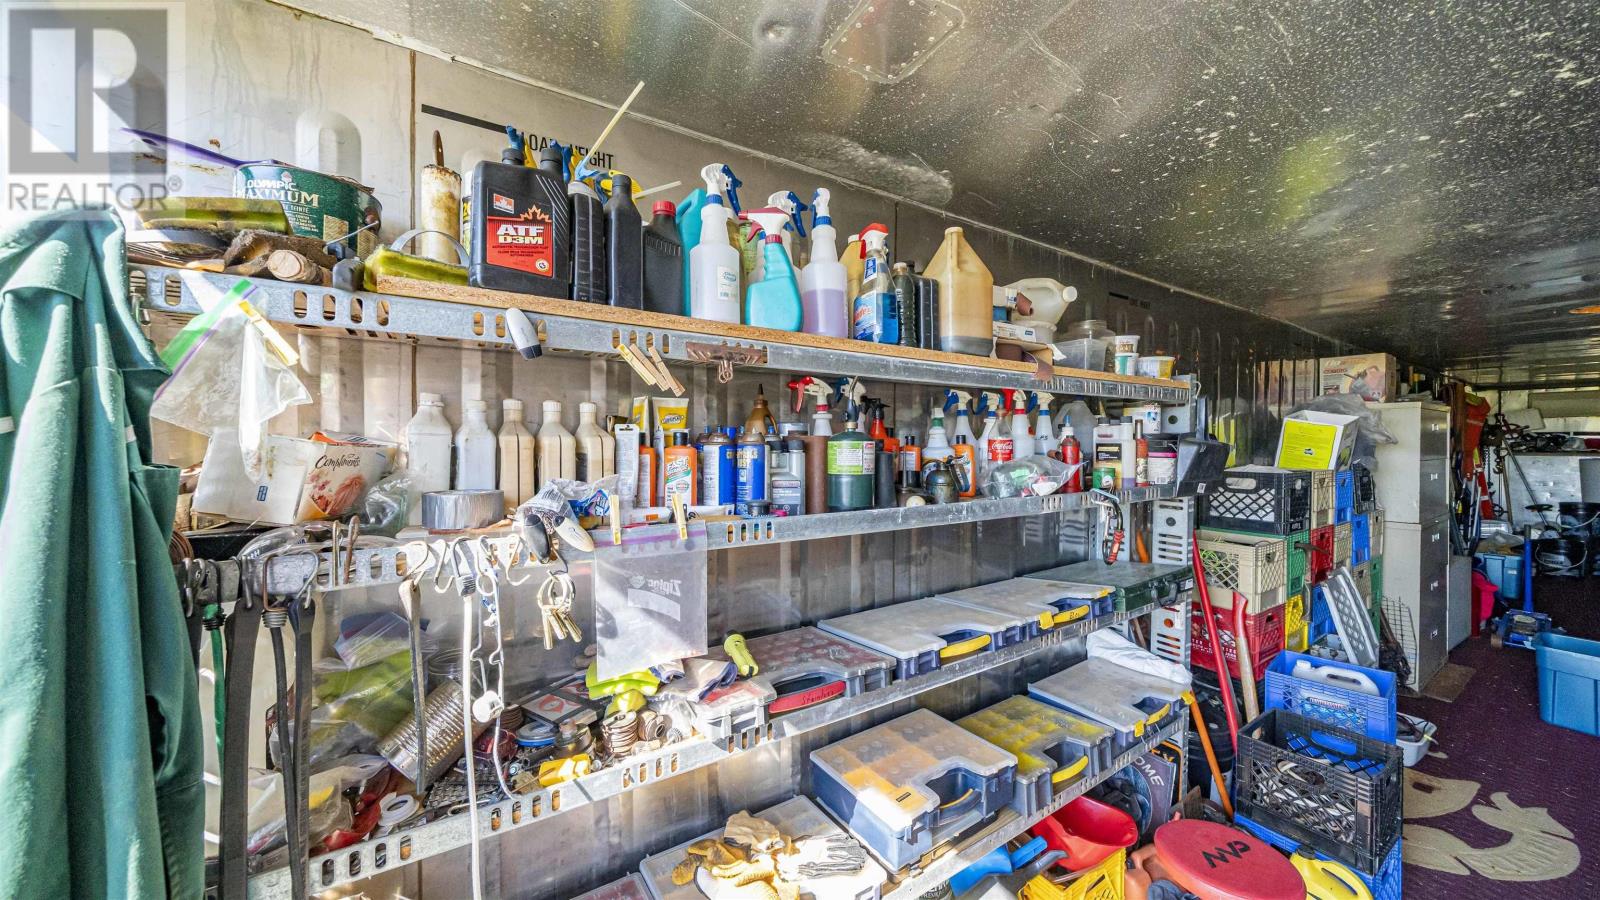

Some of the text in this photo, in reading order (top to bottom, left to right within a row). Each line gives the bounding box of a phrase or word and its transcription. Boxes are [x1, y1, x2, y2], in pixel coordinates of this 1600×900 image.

[247, 179, 299, 191] OLYMPIC
[496, 224, 545, 237] ATF
[498, 235, 544, 245] D3M
[315, 454, 361, 471] Compliments
[1133, 756, 1165, 786] OME
